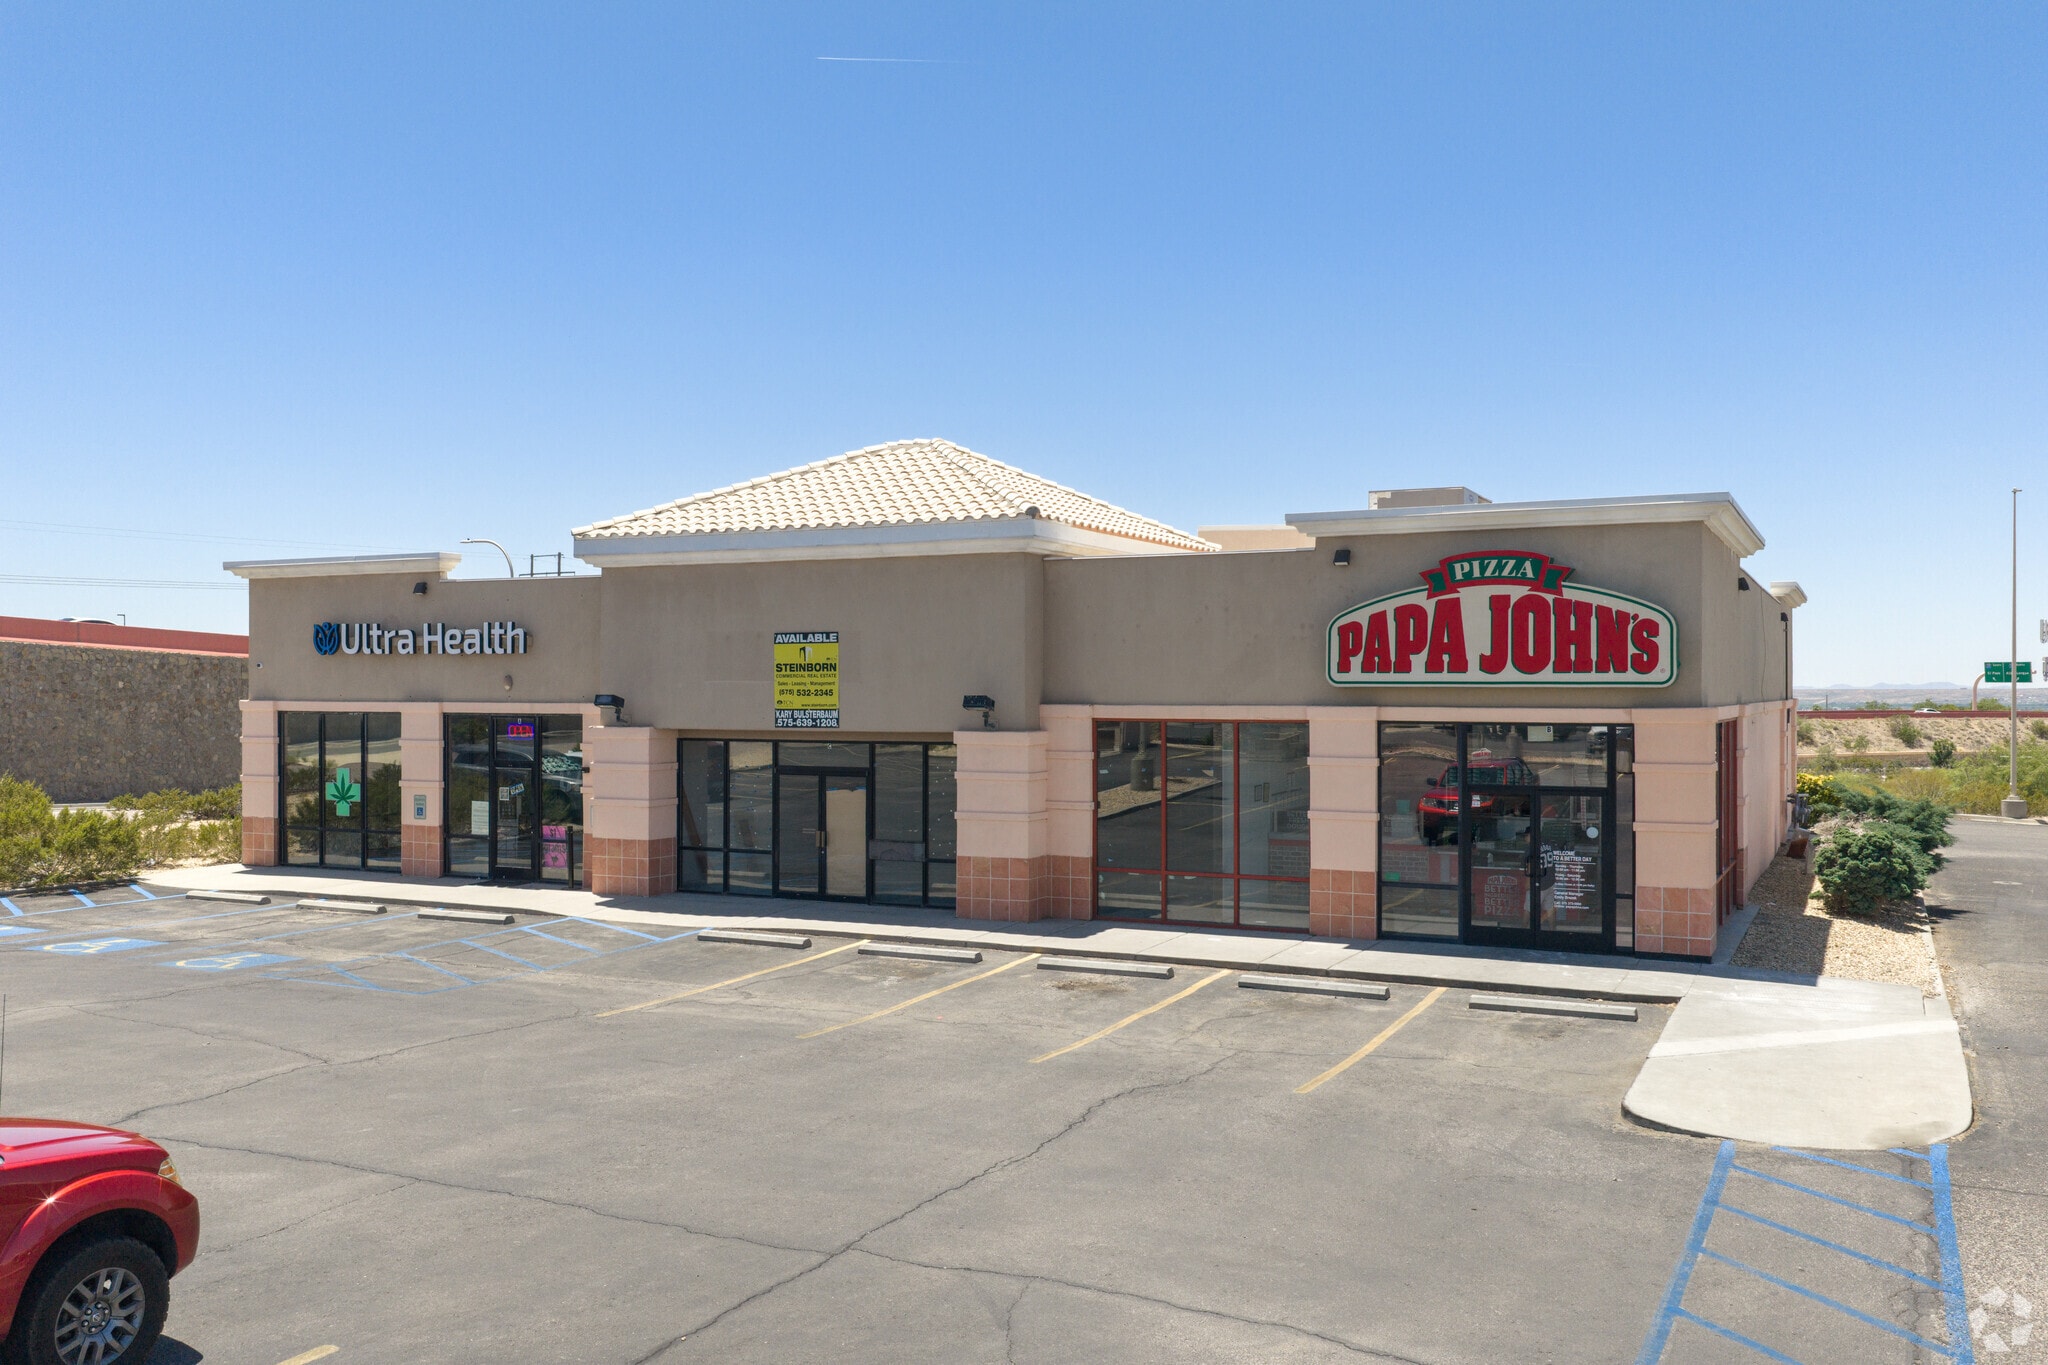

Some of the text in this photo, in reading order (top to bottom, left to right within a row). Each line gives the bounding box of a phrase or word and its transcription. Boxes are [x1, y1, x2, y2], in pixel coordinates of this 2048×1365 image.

[1453, 558, 1535, 581] PIZZA
[341, 621, 527, 655] Ultra Health
[775, 633, 837, 643] AVAILABLE
[1337, 593, 1660, 675] PAPA JOHN'S
[776, 663, 836, 672] STEINBORN
[775, 710, 838, 718] KARY BULSTERBAUM
[777, 719, 837, 727] 575-639-1208
[510, 725, 533, 737] OPEN
